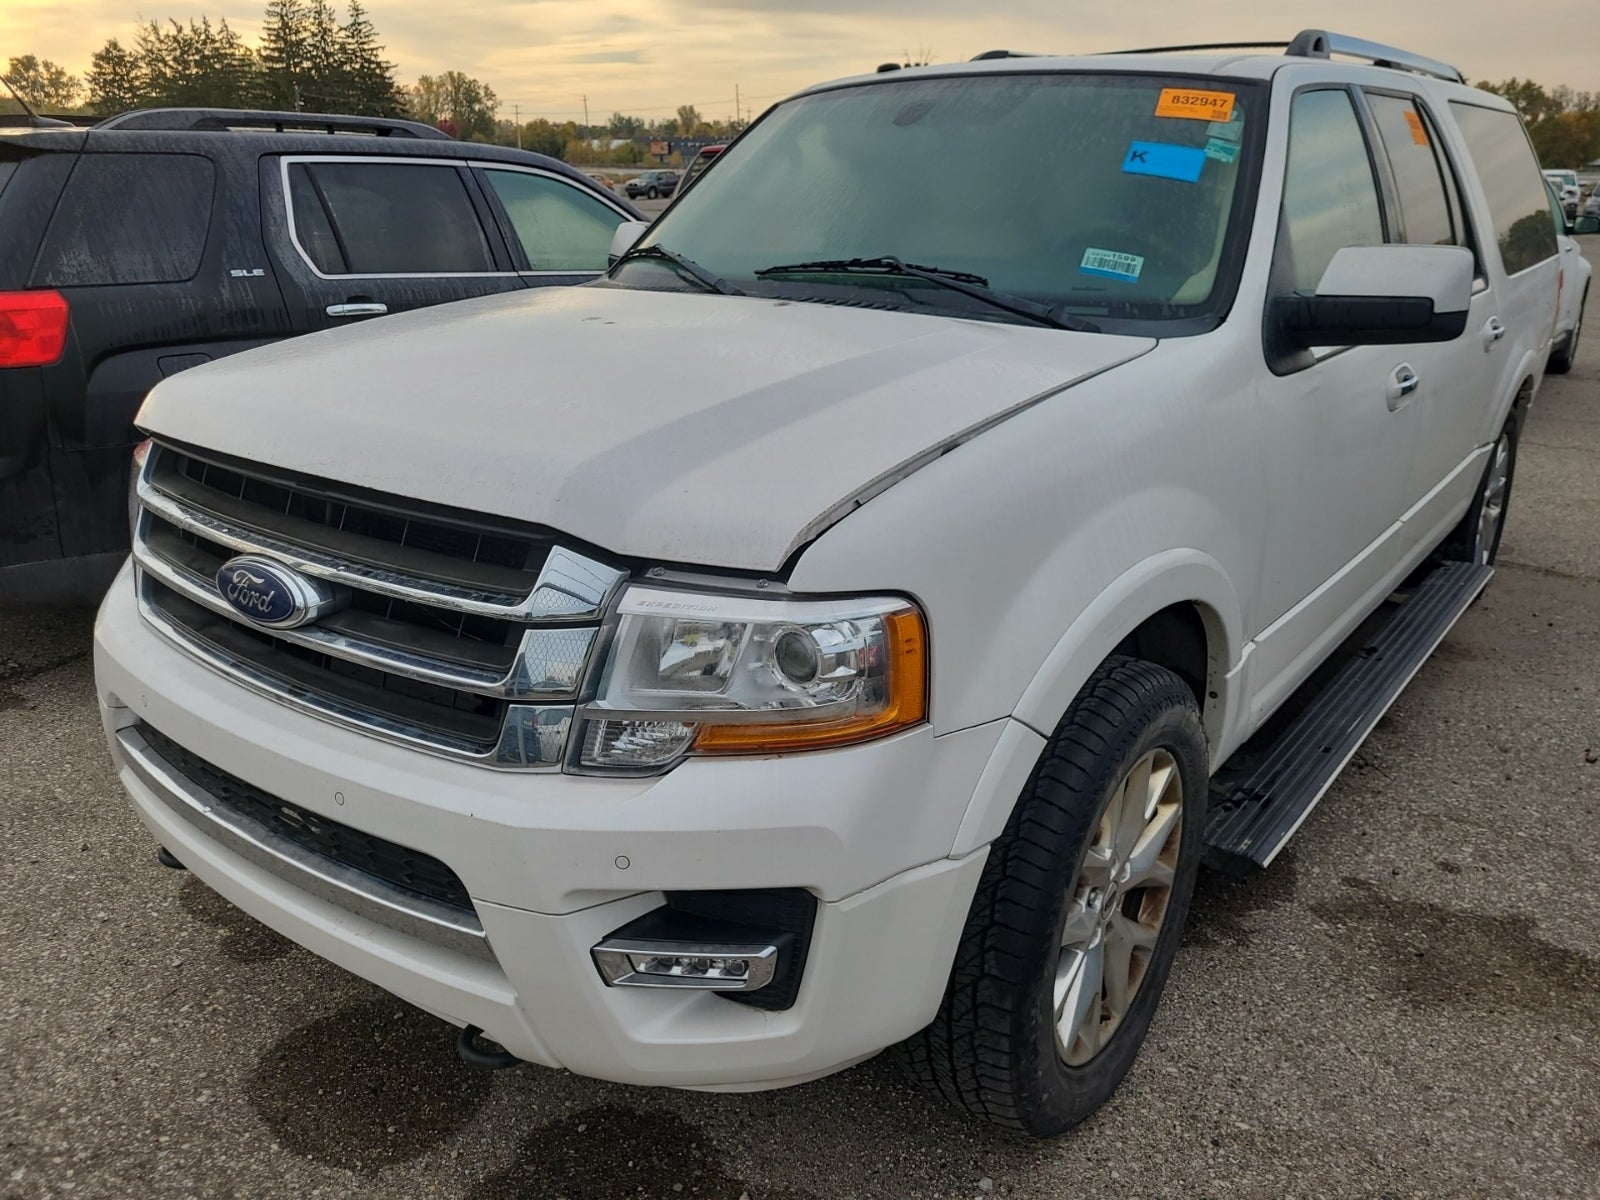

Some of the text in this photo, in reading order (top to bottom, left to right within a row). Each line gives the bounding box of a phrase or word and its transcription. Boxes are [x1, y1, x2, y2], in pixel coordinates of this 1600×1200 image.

[1171, 95, 1228, 108] 832947
[1129, 150, 1149, 163] K
[230, 268, 266, 277] SLE
[227, 569, 276, 613] Ford
[637, 600, 719, 612] EXPEDITION
